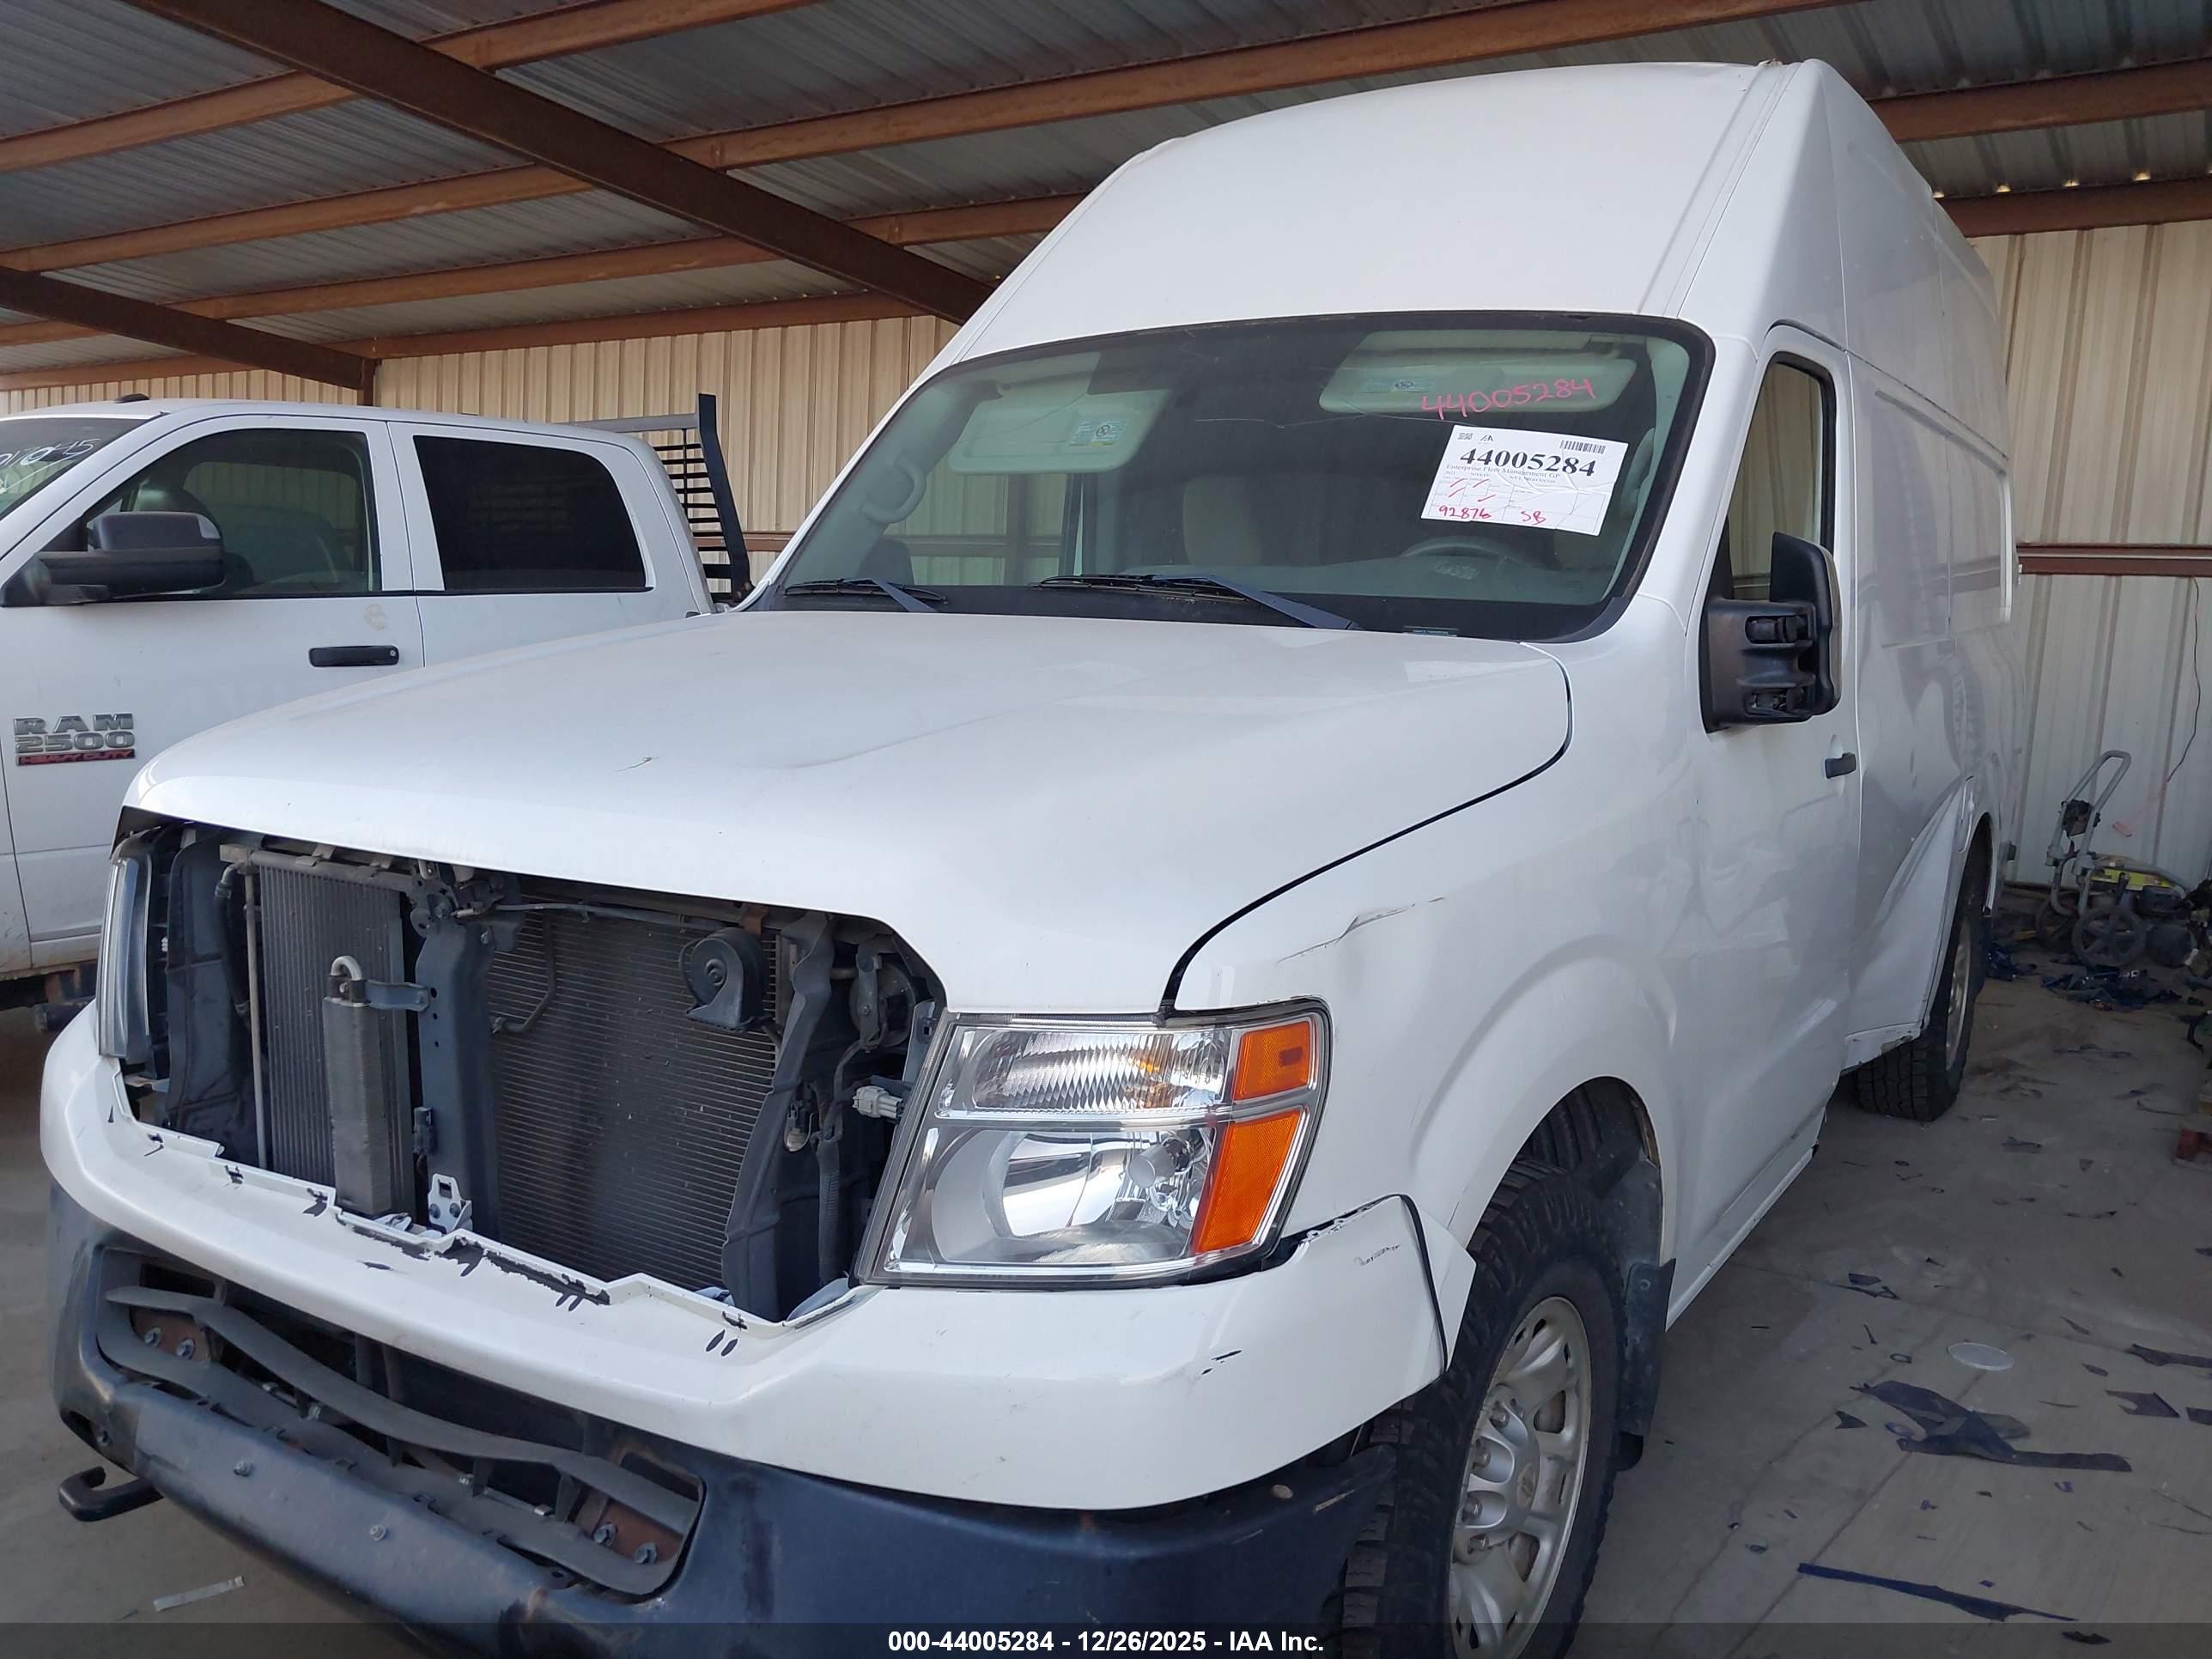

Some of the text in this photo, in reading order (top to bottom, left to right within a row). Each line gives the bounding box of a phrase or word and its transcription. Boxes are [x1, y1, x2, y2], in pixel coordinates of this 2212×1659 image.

[1422, 379, 1595, 420] 44005284
[1460, 447, 1596, 477] 44005284
[1502, 468, 1547, 478] Management
[1438, 504, 1492, 520] 92876
[14, 713, 134, 736] RAM
[15, 731, 136, 754] 2500
